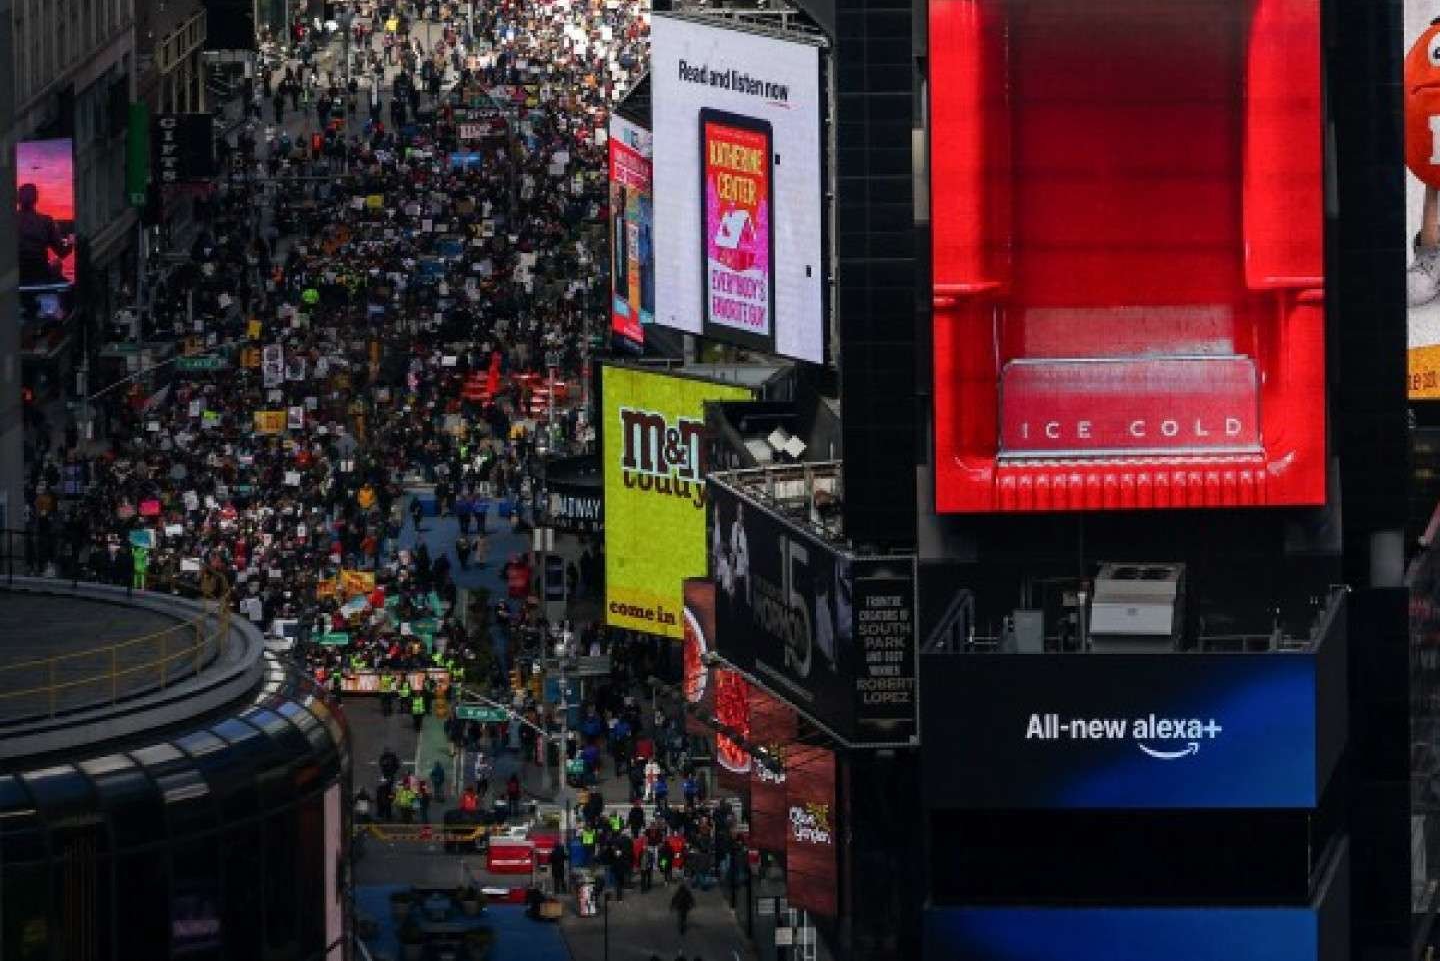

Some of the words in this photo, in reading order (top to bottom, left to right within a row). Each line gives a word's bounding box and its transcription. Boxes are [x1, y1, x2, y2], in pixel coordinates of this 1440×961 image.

[679, 59, 707, 85] Read
[710, 69, 730, 90] and
[732, 71, 763, 97] listen
[765, 82, 788, 101] now
[1021, 420, 1092, 439] ICE
[1129, 418, 1242, 437] COLD
[609, 601, 654, 620] come
[657, 605, 677, 626] in
[1025, 714, 1126, 740] All-new
[1132, 714, 1223, 740] alexa+
